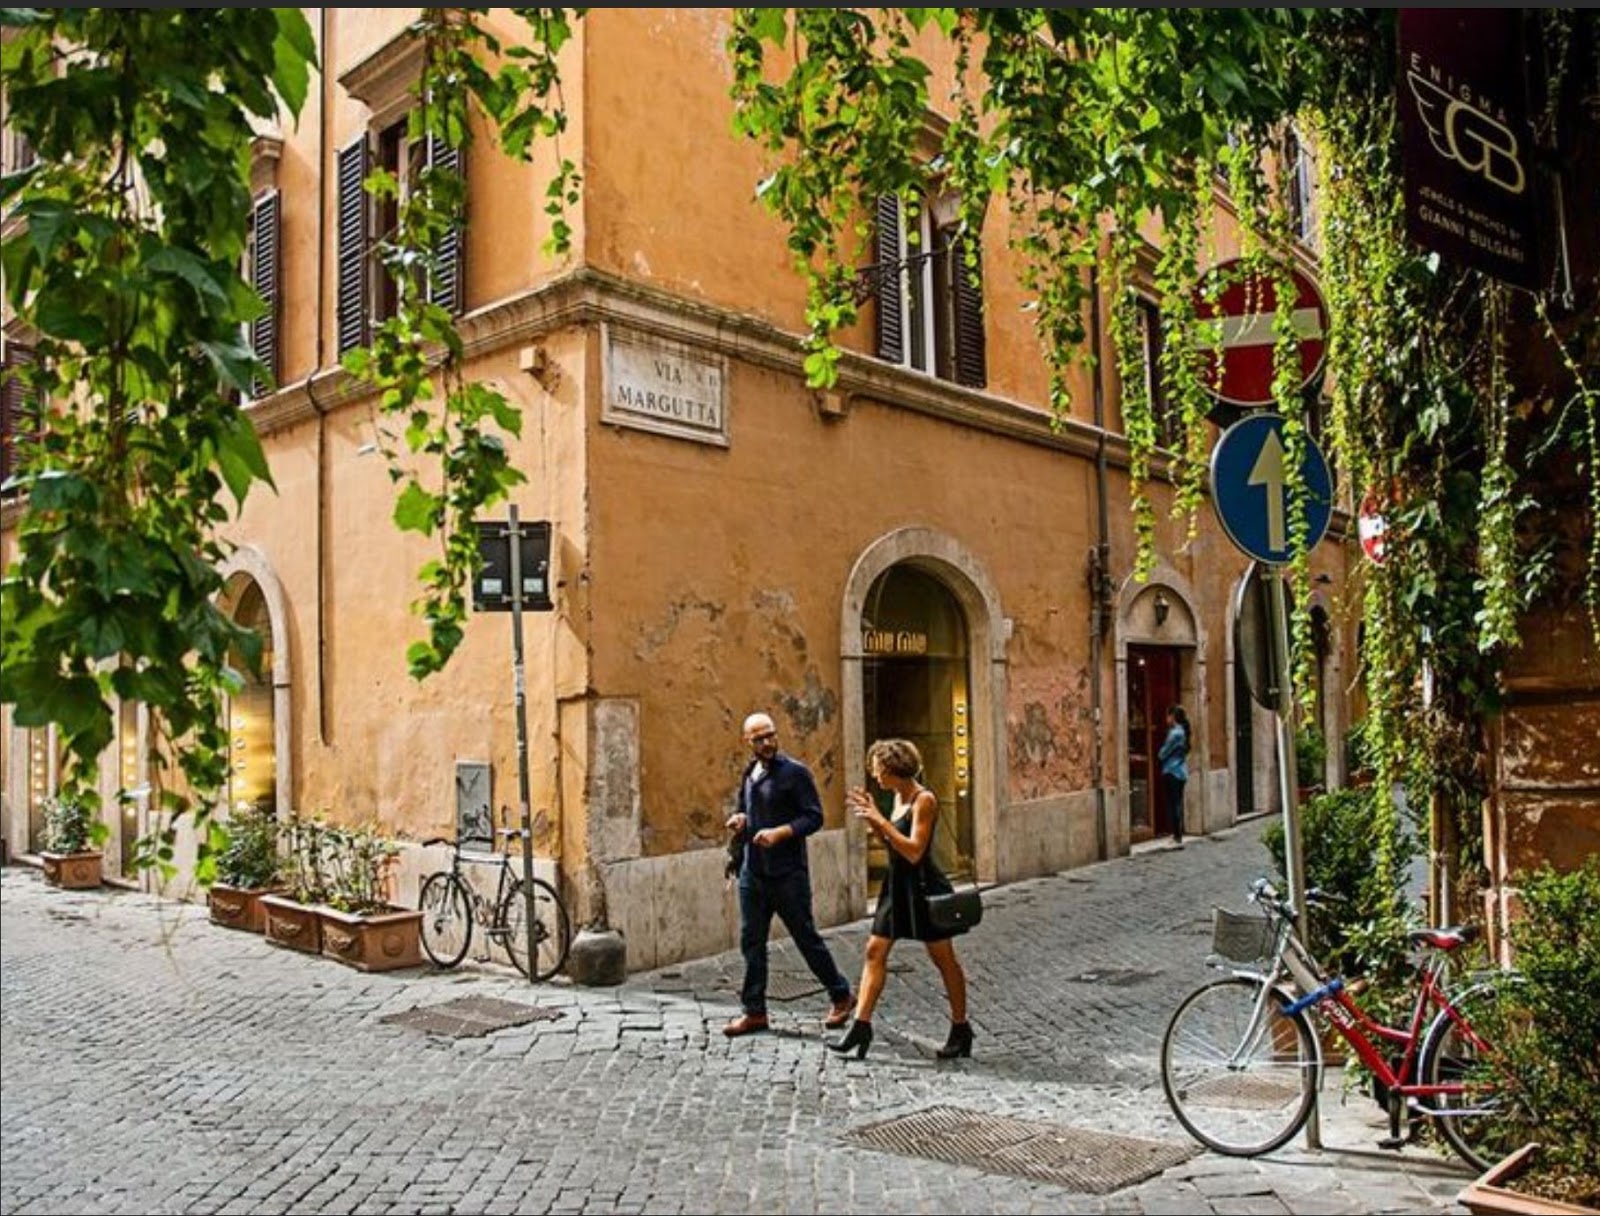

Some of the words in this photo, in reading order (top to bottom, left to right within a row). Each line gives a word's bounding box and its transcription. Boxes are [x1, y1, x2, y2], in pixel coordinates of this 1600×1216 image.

[1410, 51, 1507, 122] ENIGMA
[1418, 204, 1466, 237] GIANNI
[1469, 228, 1525, 263] BULGARI
[654, 360, 682, 385] VIA
[618, 385, 717, 425] MARGUTTA
